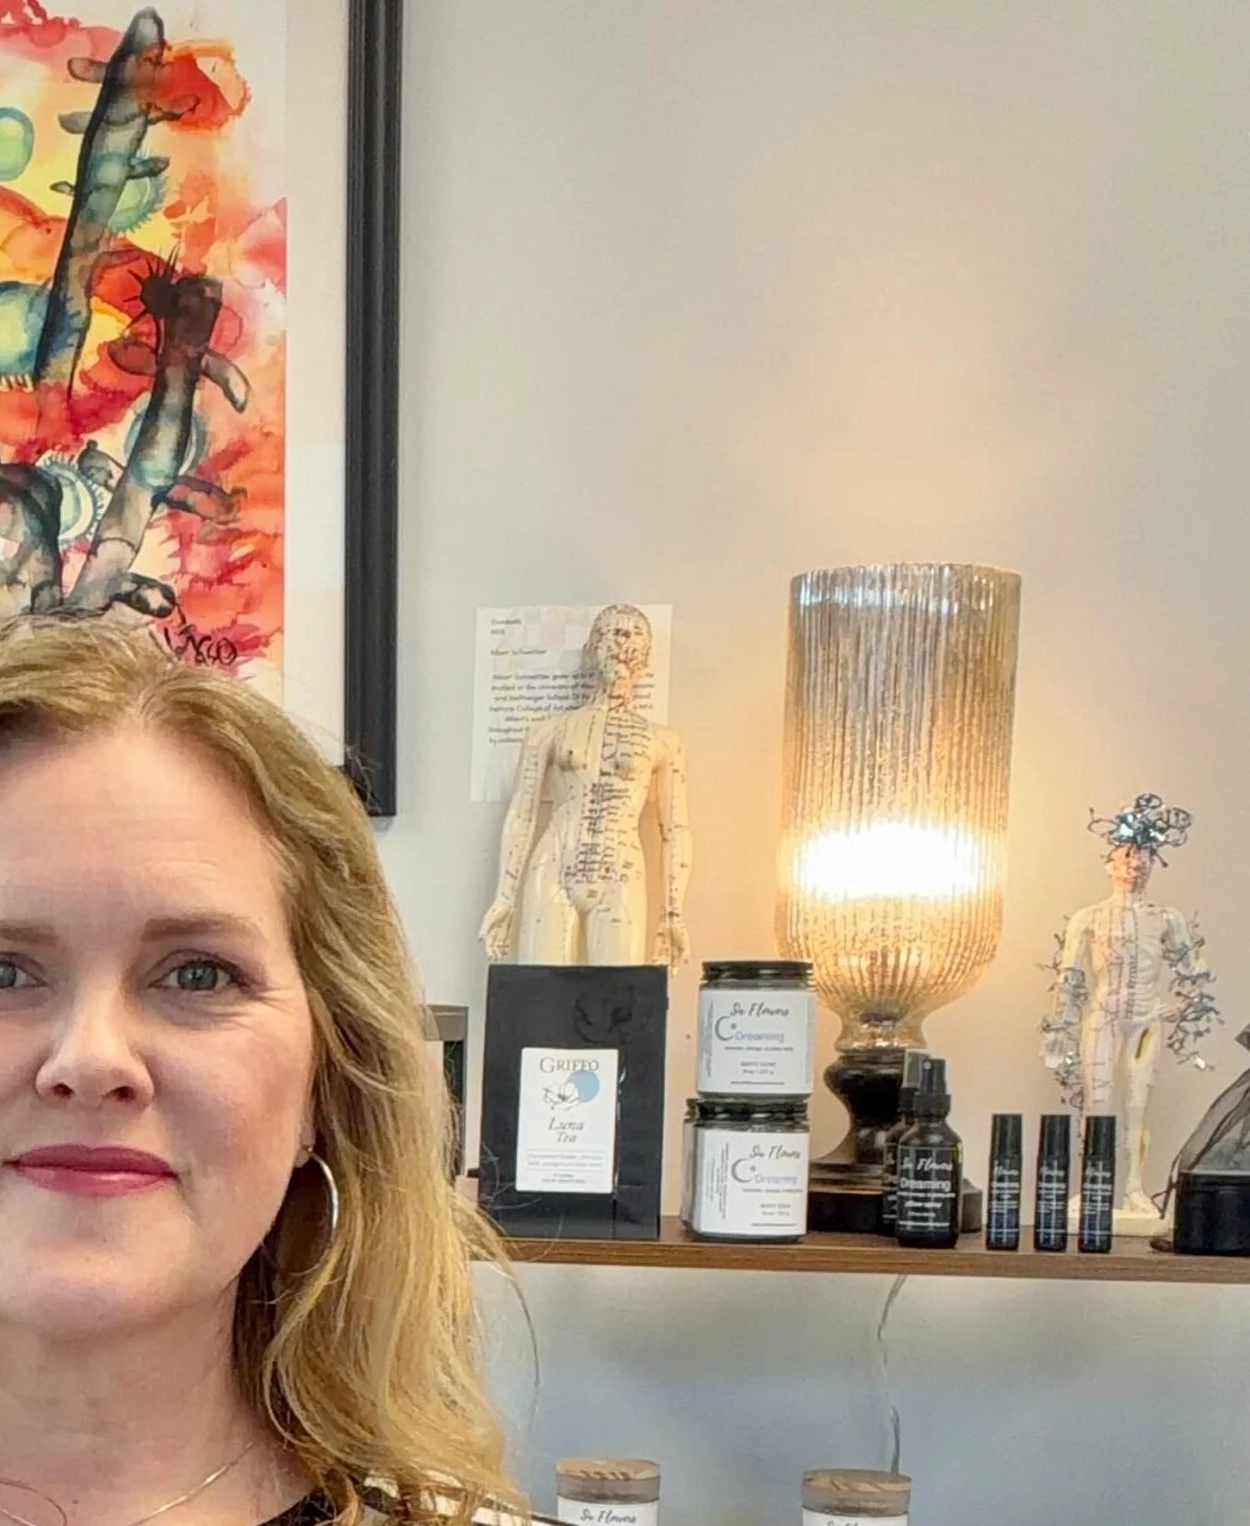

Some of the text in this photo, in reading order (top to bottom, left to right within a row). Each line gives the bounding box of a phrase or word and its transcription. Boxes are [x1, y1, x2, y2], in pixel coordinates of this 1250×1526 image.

[749, 1001, 790, 1018] Flowers
[548, 1117, 586, 1131] Luna
[556, 1132, 577, 1143] Tea
[900, 1177, 952, 1192] Dreaming
[597, 1509, 637, 1524] Flowers
